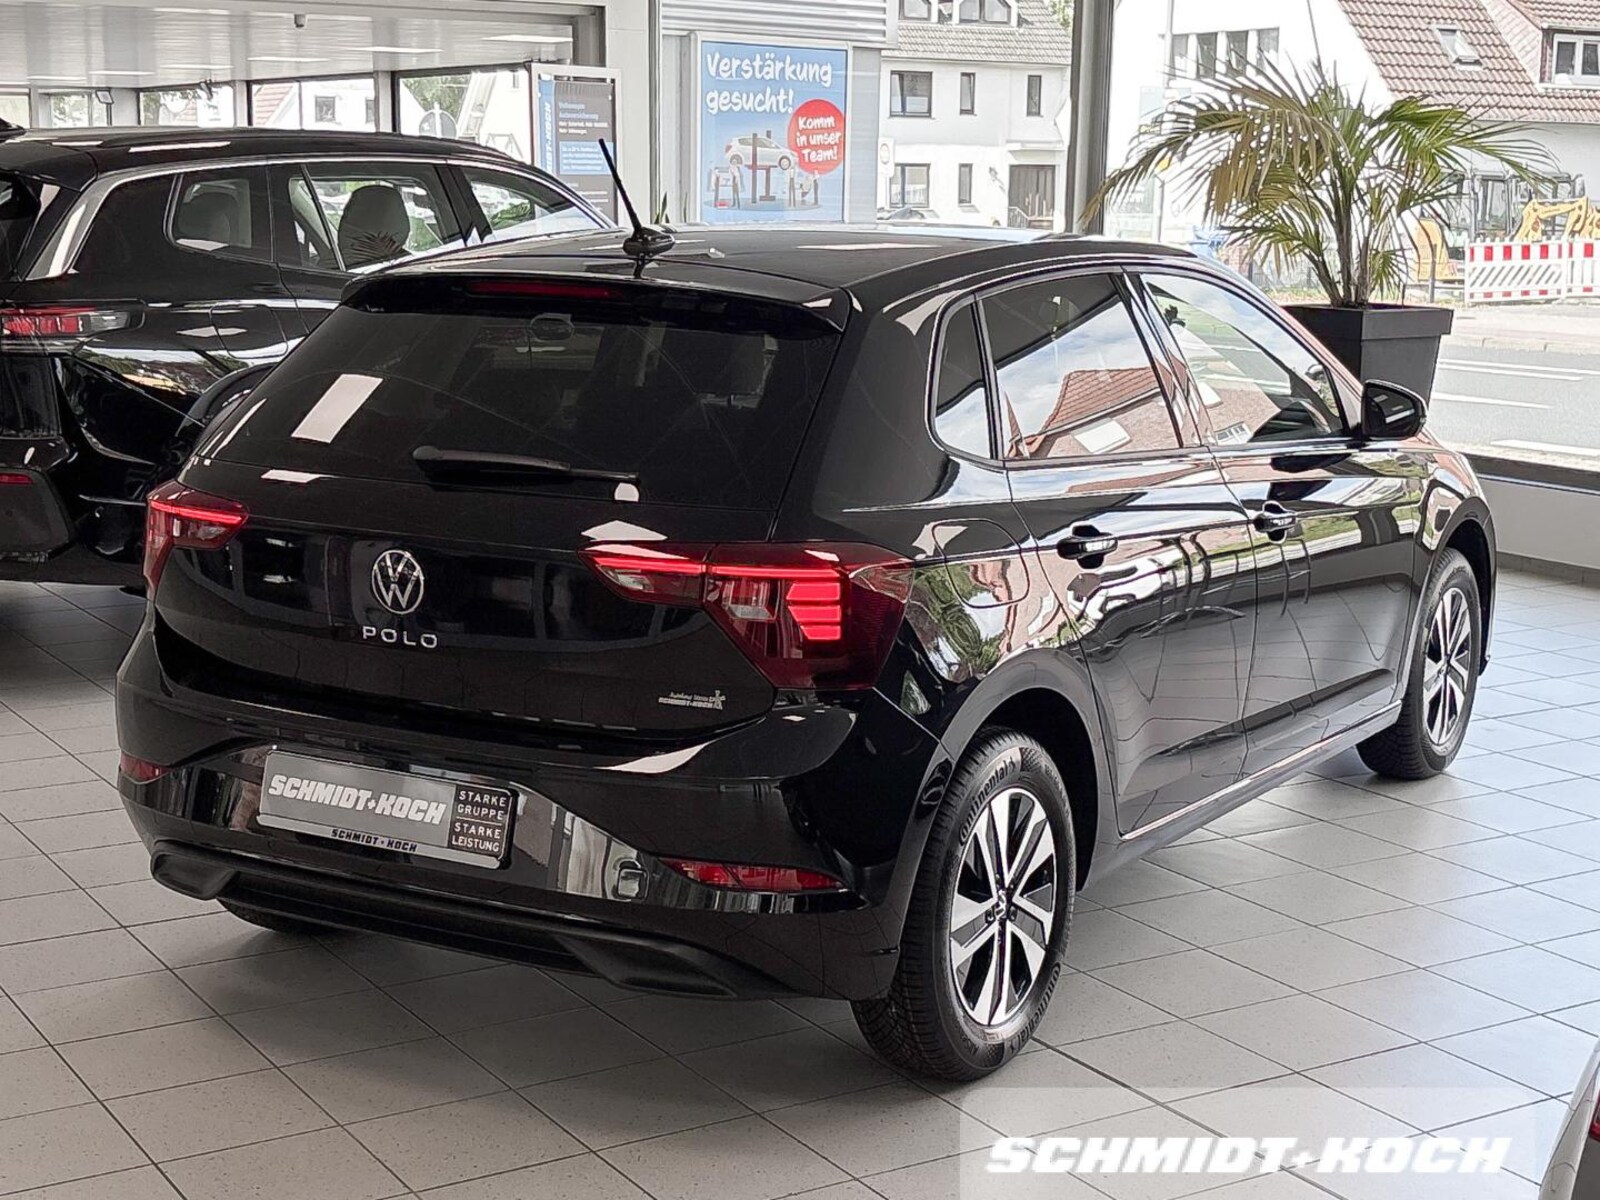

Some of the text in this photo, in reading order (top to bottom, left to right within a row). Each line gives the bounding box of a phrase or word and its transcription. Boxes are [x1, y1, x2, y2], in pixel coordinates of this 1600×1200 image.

[706, 52, 832, 88] Verstärkung
[706, 86, 794, 115] gesucht!
[798, 115, 836, 130] Komm
[796, 131, 842, 147] in unser
[801, 146, 838, 162] Team!
[362, 625, 438, 649] POLO
[268, 774, 447, 825] SCHMIDT+KOCH
[459, 790, 507, 808] STARKE
[457, 803, 504, 821] GRUPPE
[454, 822, 501, 839] STARKE
[451, 835, 500, 853] LEISTUNG
